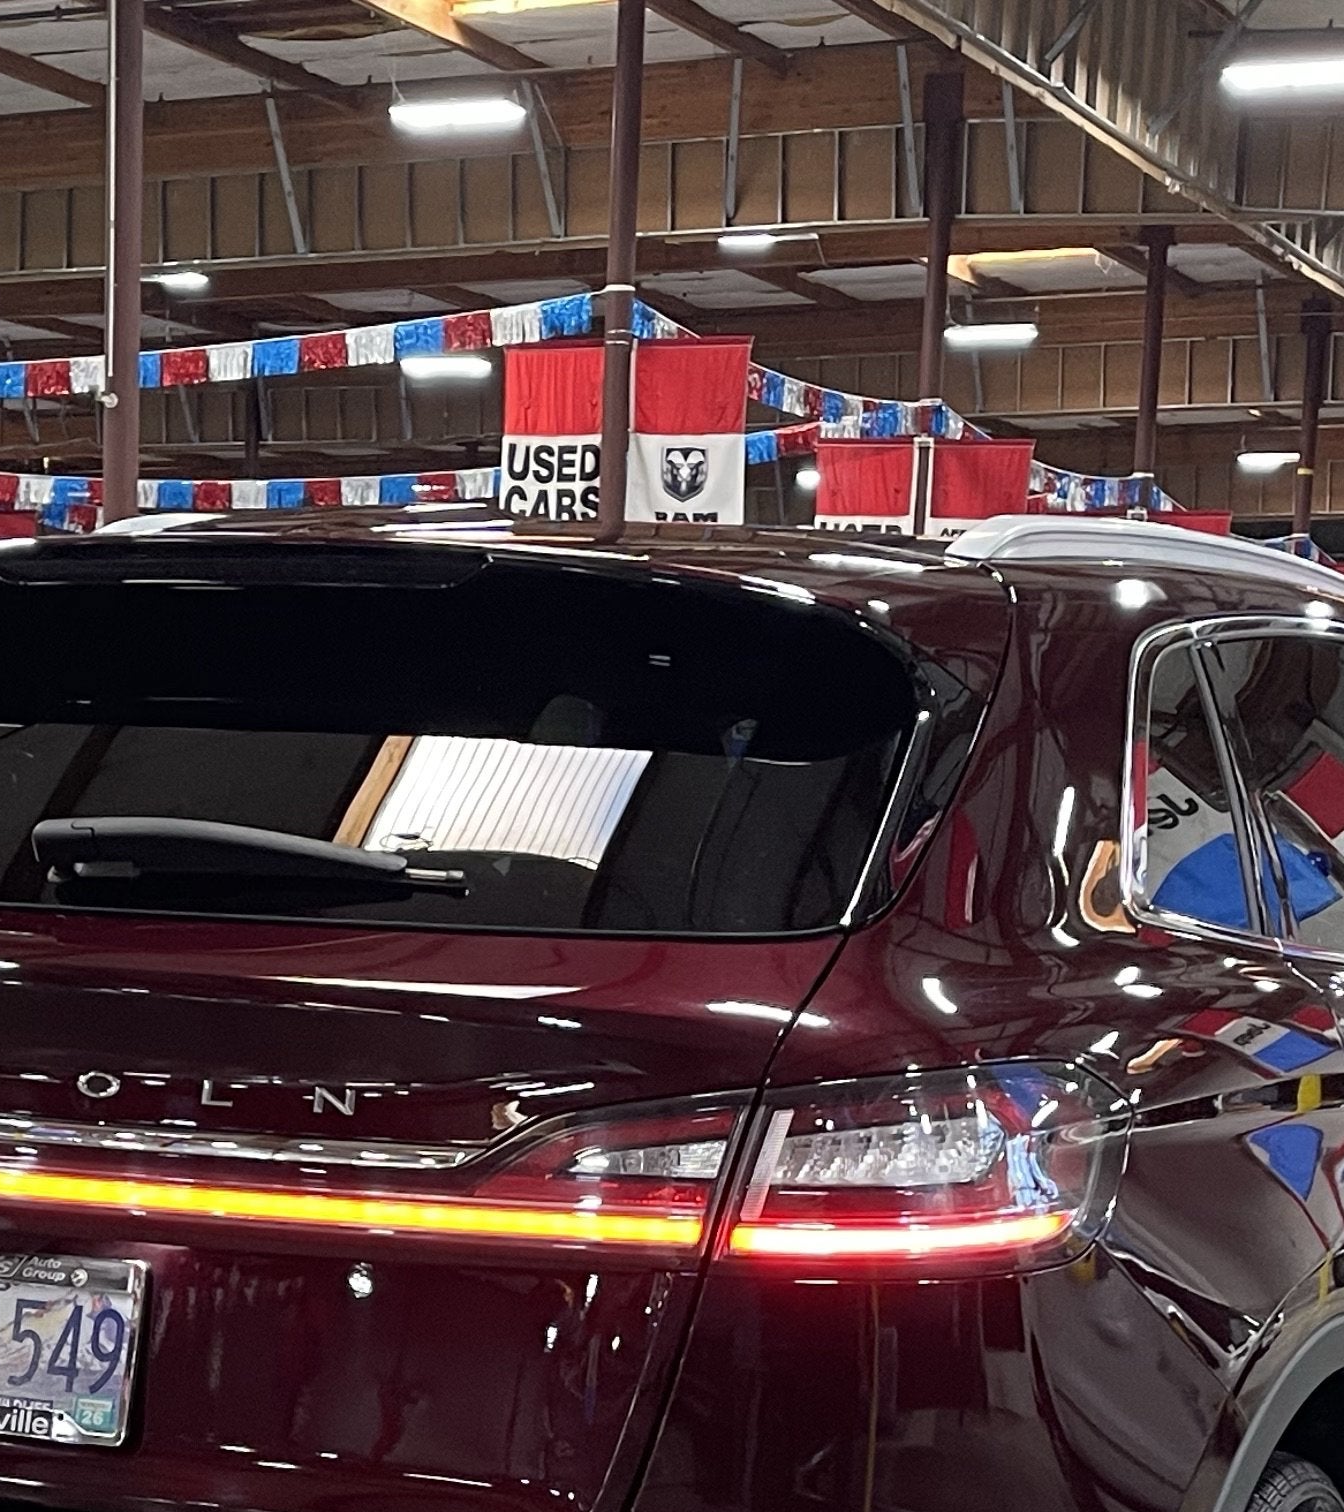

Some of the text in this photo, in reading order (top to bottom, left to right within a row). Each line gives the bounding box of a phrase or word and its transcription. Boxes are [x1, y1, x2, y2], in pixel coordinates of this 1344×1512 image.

[508, 443, 601, 484] USED
[27, 1256, 63, 1269] Auto
[22, 1267, 67, 1282] Group
[80, 1410, 105, 1426] 26
